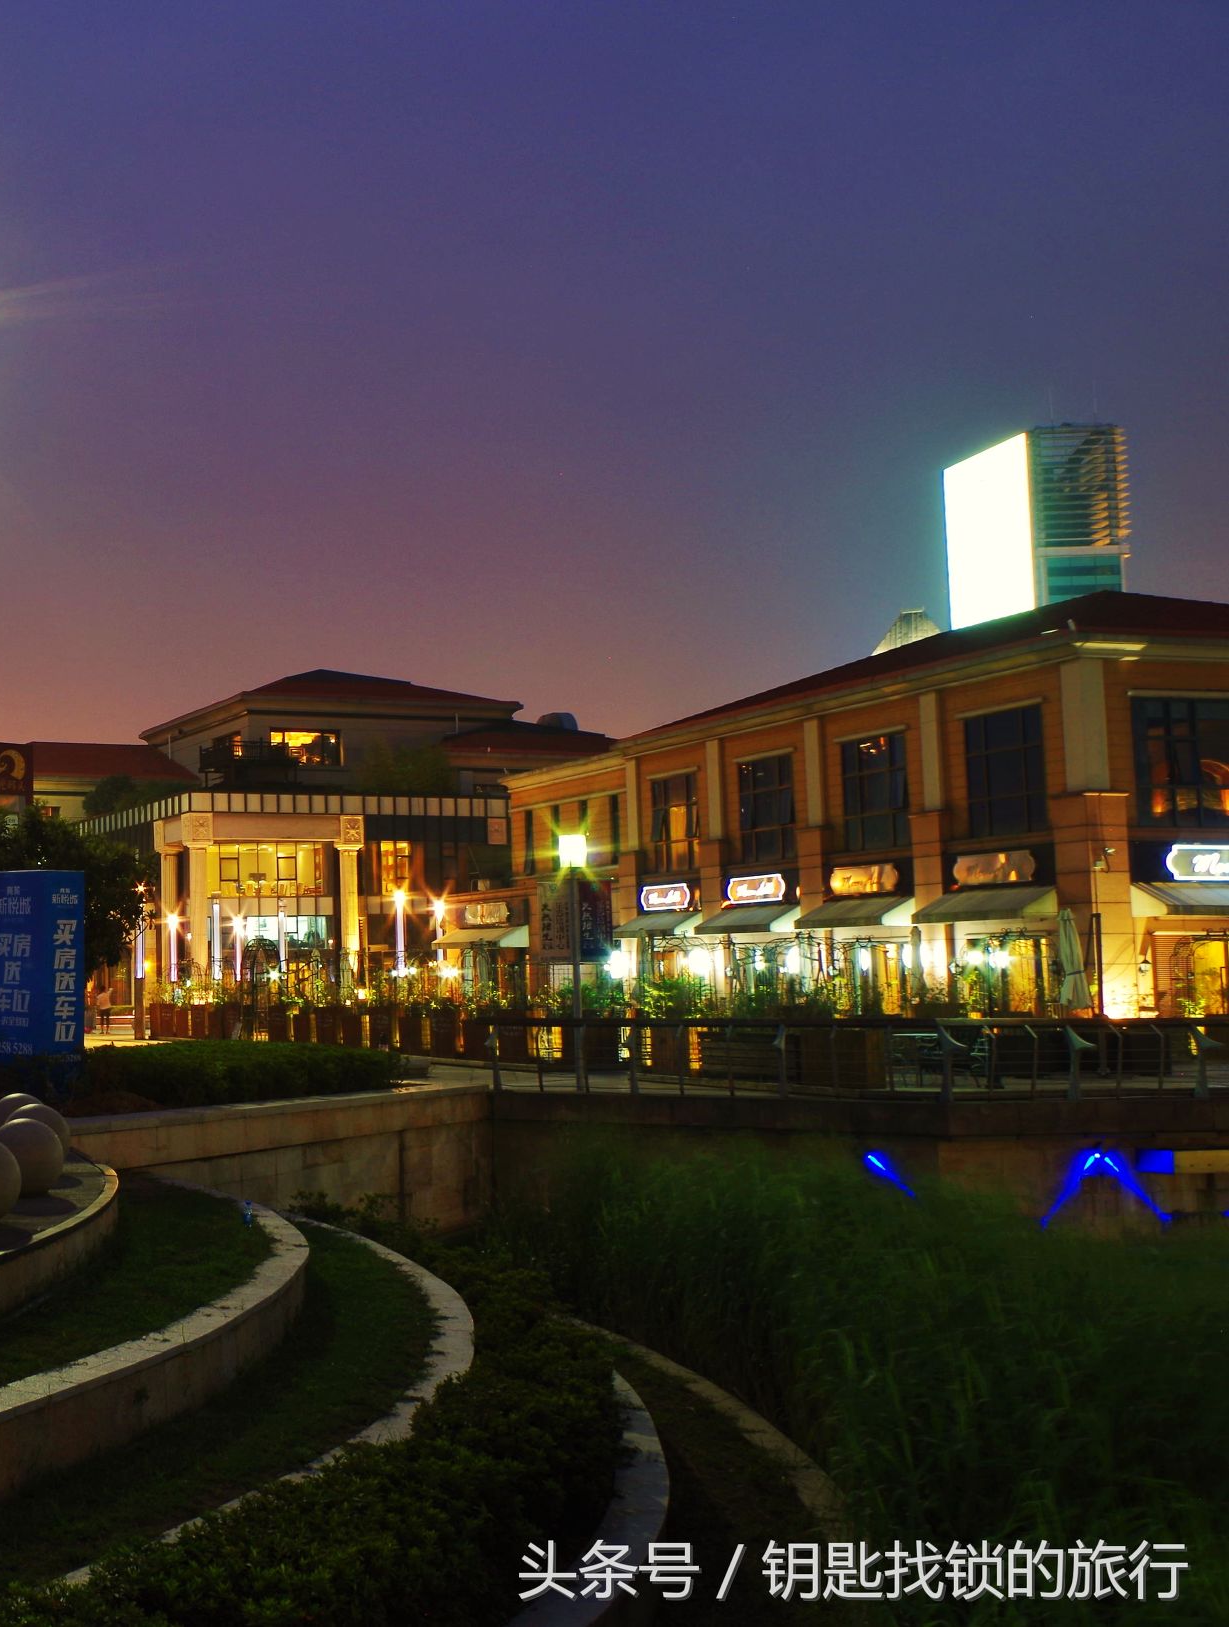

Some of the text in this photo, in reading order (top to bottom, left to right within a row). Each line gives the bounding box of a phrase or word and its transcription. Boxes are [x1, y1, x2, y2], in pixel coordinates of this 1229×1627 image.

[53, 919, 77, 1043] 买房送车位
[13, 1042, 33, 1056] 5288
